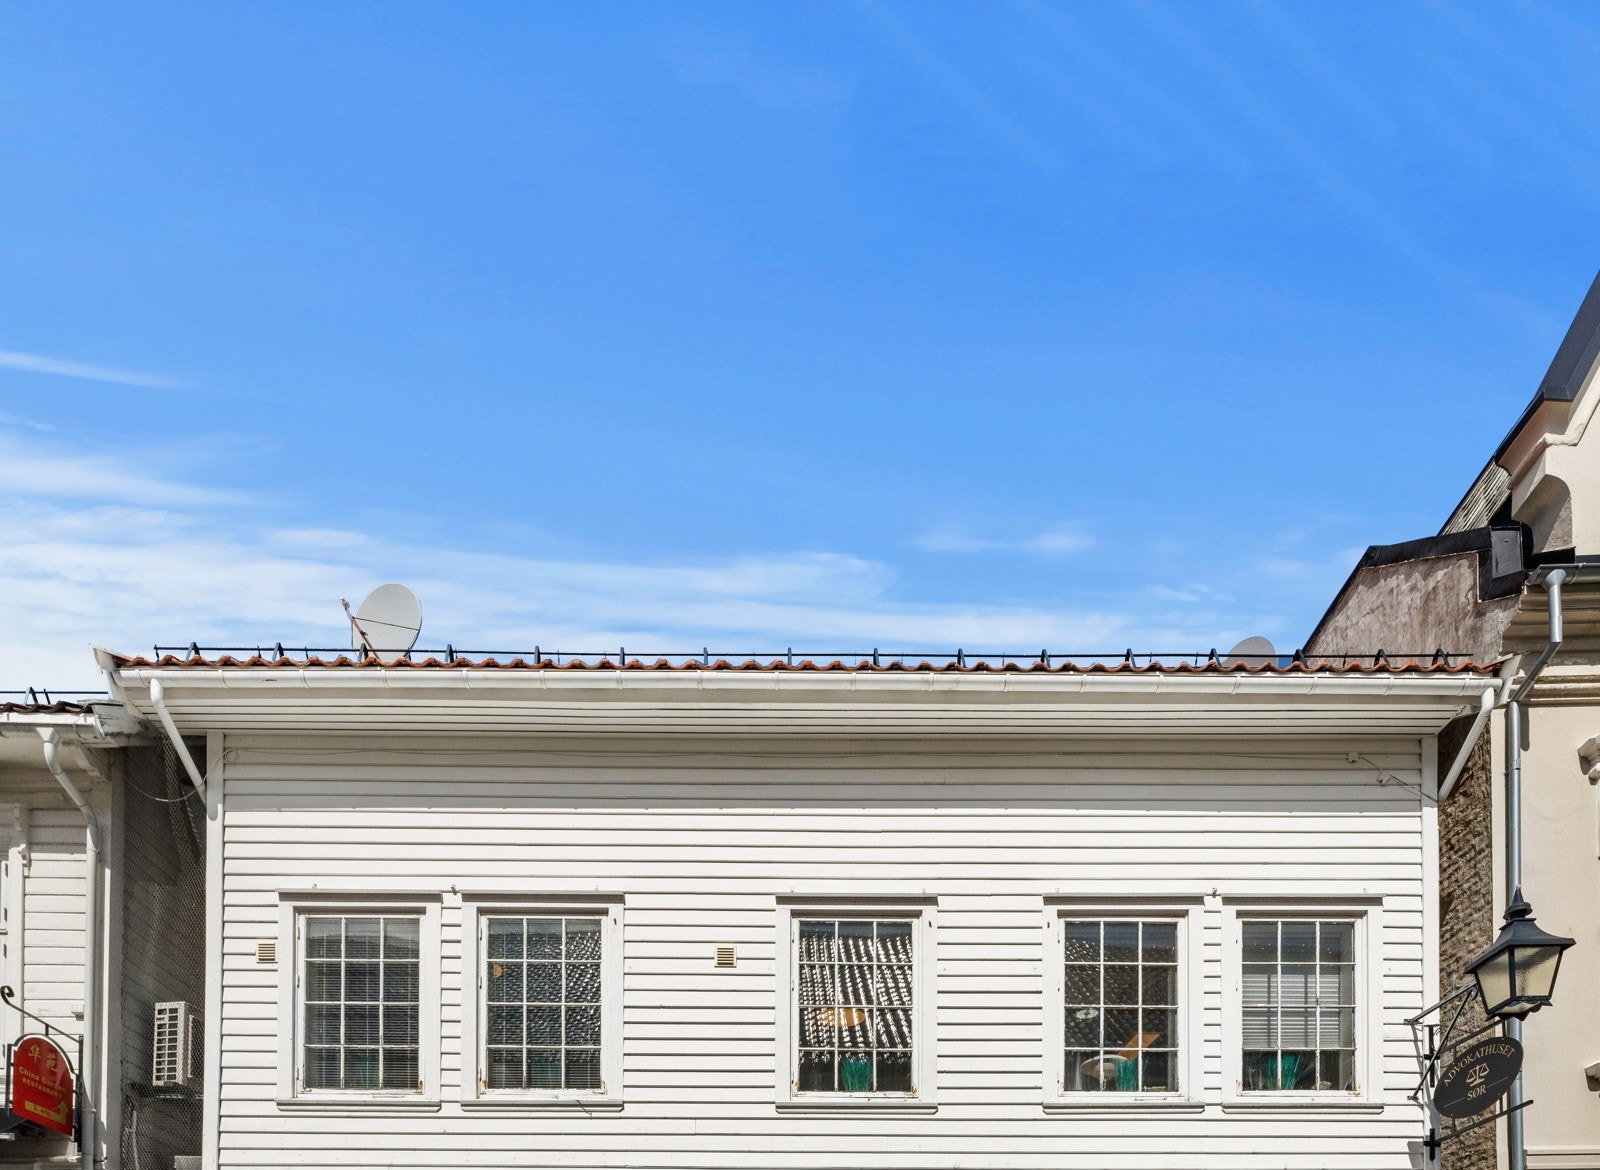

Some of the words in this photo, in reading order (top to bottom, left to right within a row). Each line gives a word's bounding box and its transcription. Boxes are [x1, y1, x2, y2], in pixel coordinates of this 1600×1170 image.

[1443, 1043, 1516, 1087] ADVOKATHUSET
[19, 1066, 40, 1082] China
[1467, 1084, 1487, 1101] SØR
